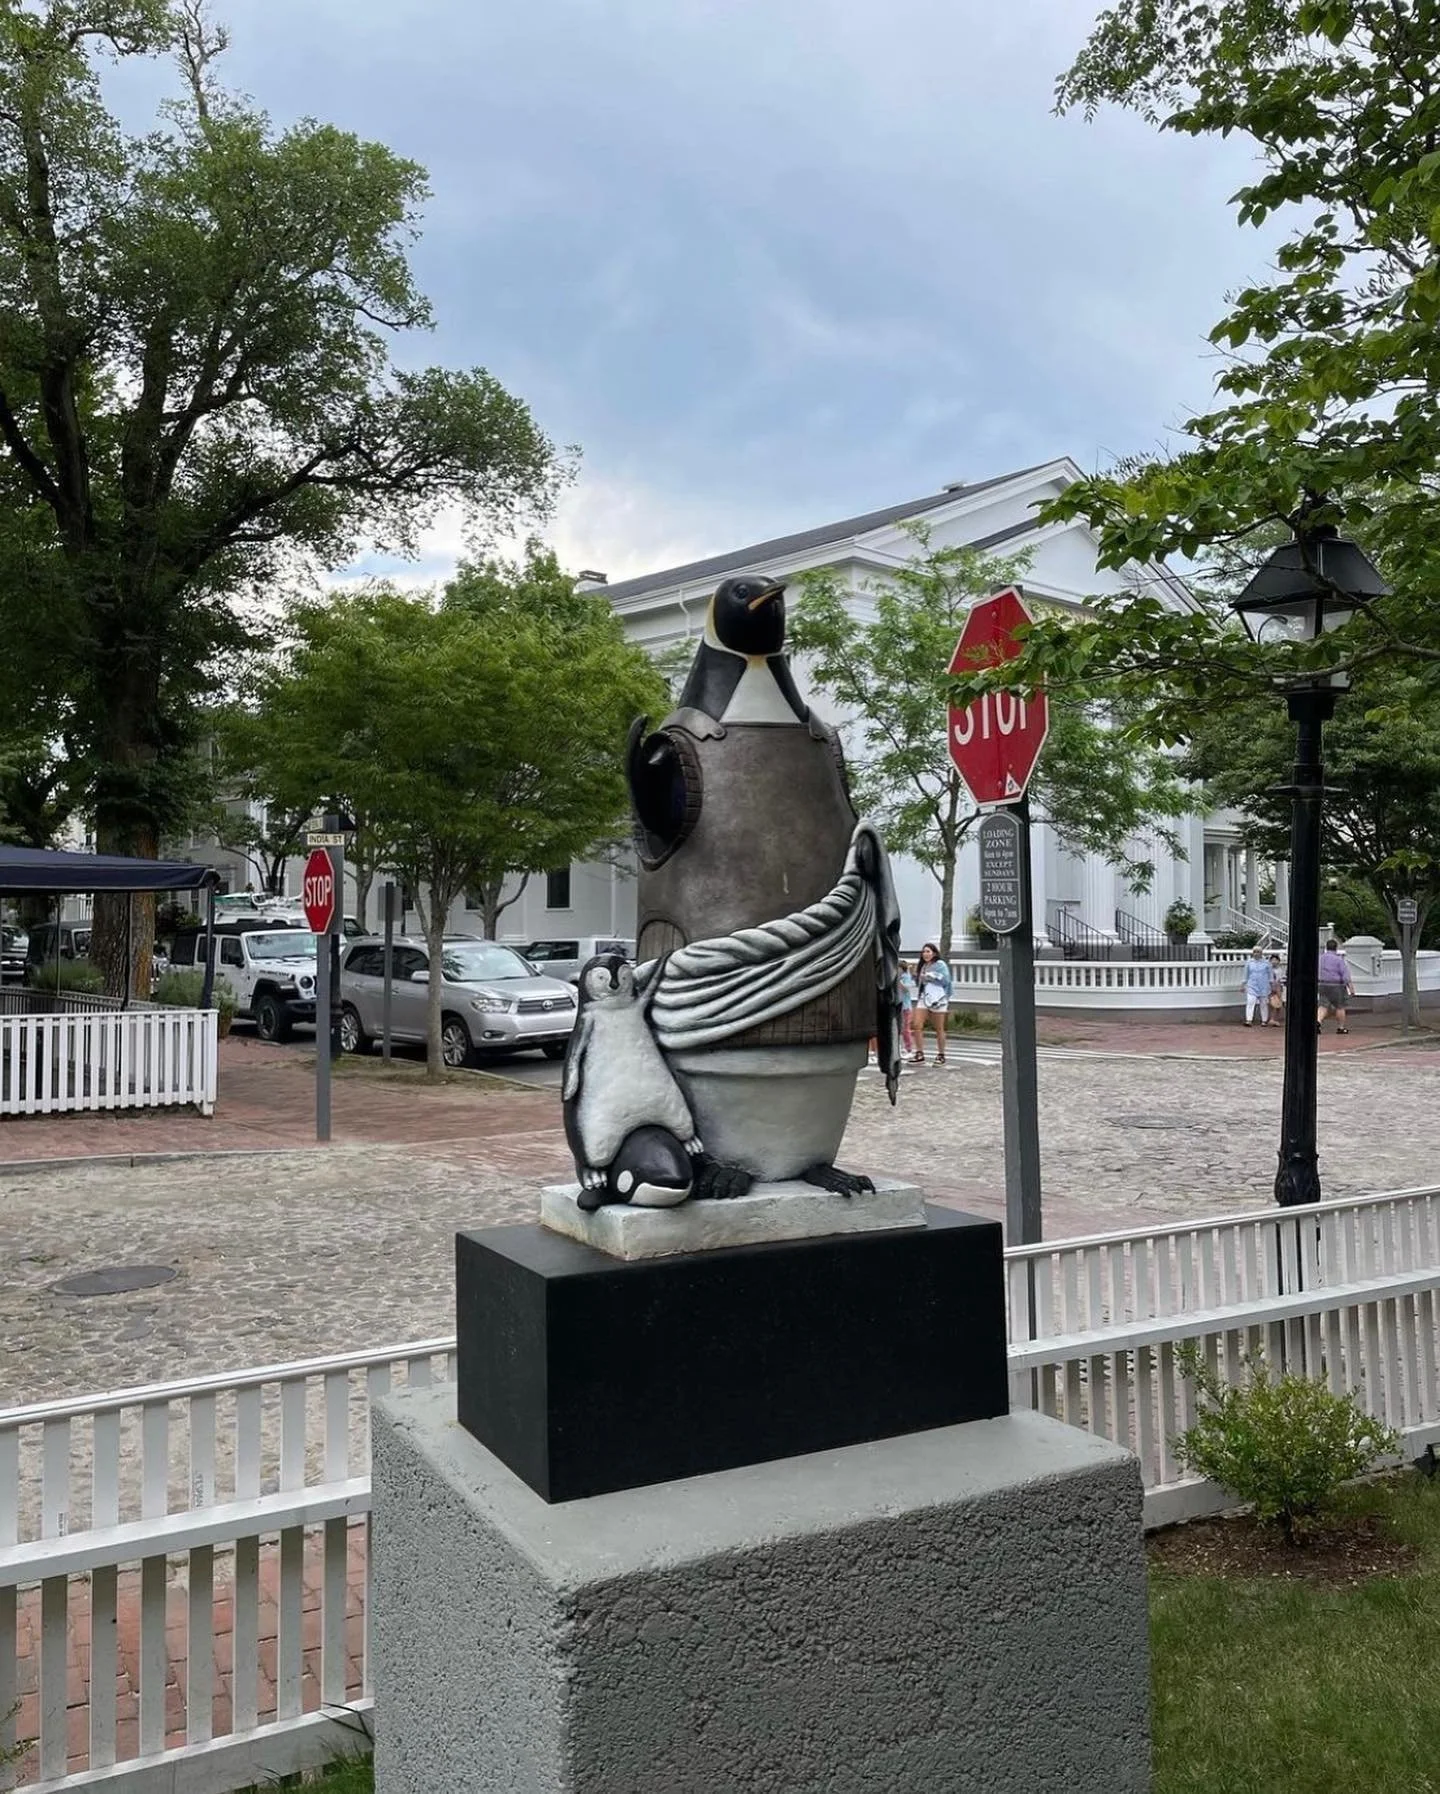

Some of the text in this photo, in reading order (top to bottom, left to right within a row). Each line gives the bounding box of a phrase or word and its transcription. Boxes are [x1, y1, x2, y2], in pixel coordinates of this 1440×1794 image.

[309, 835, 342, 843] INDIA ST
[983, 829, 1015, 839] LOADING
[986, 839, 1013, 848] ZONE
[305, 875, 331, 908] STOP
[987, 882, 1013, 892] 2 HOUR
[984, 895, 1017, 905] PARKING
